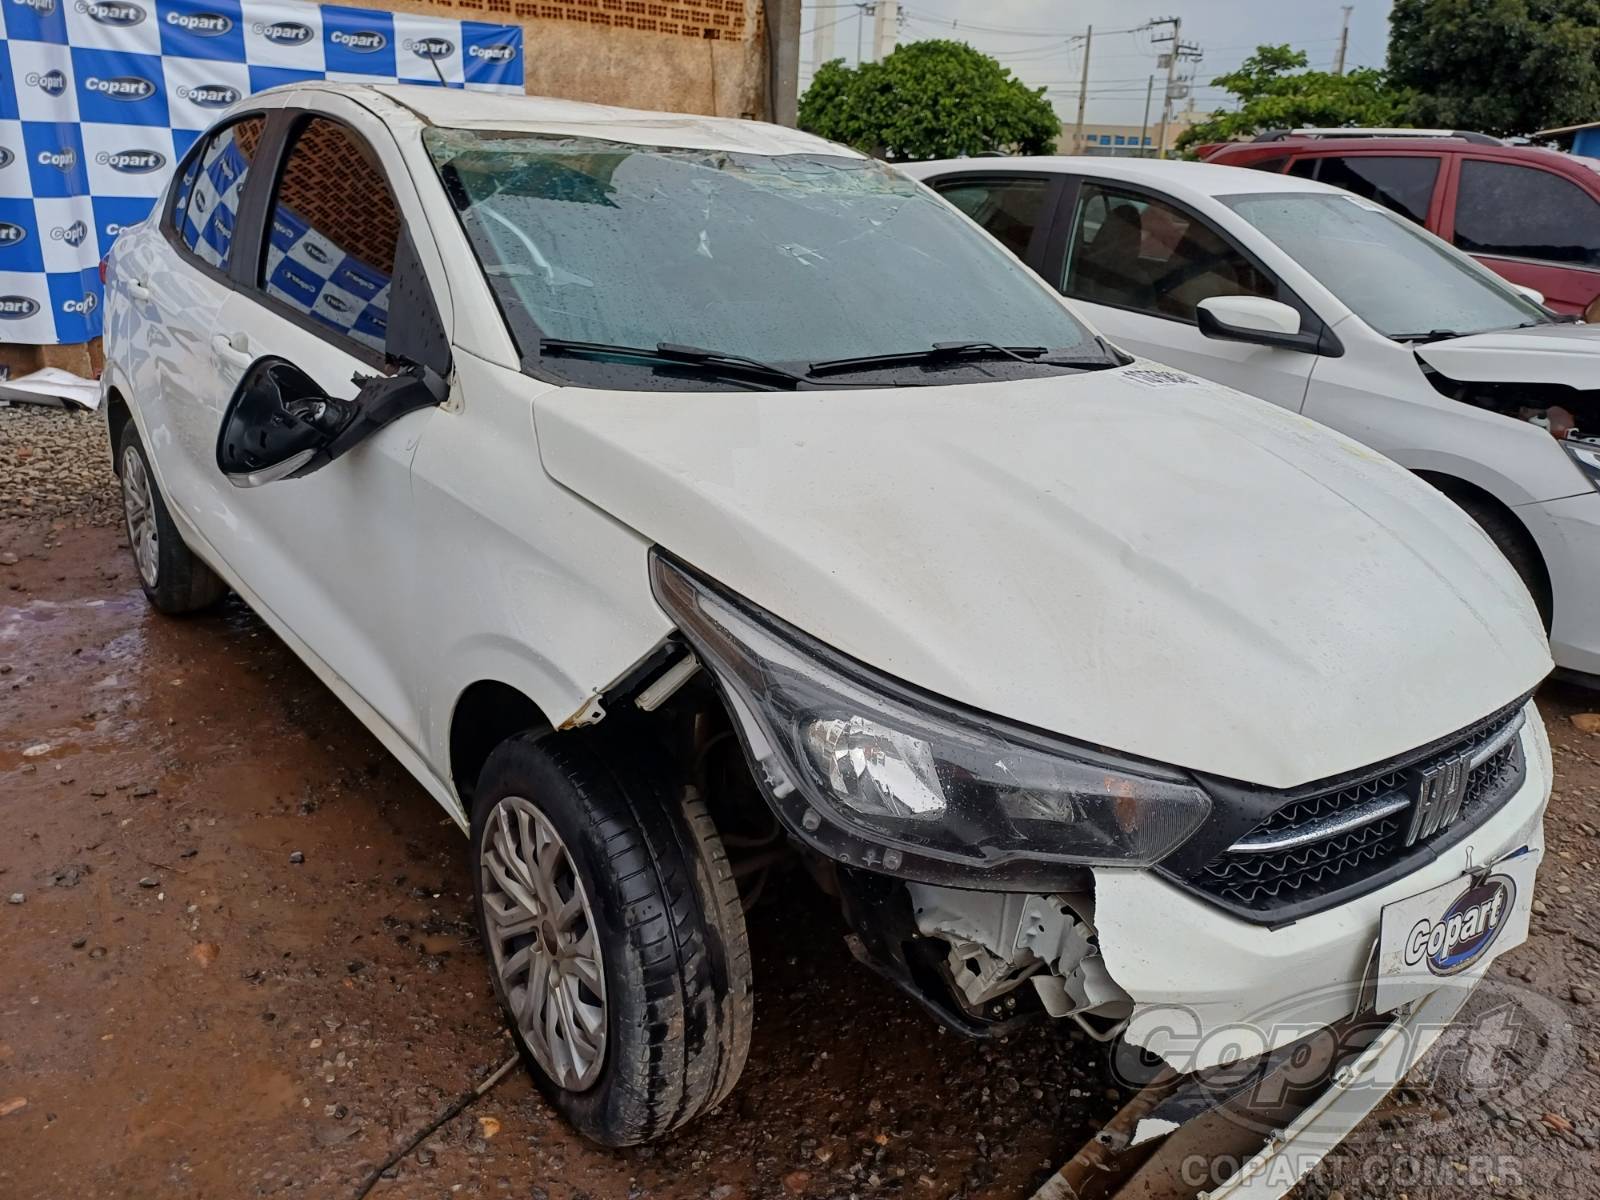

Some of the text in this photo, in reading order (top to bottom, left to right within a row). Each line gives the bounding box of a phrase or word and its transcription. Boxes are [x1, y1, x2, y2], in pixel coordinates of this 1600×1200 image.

[75, 1, 137, 23] Copart
[167, 12, 225, 31] Copart
[252, 22, 306, 40] Copart
[331, 31, 380, 47] Copart
[468, 45, 511, 59] Copart
[85, 77, 147, 97] Copart
[176, 85, 233, 104] Copart
[95, 150, 156, 168] Copart
[0, 297, 29, 313] art
[1404, 881, 1505, 966] Copart
